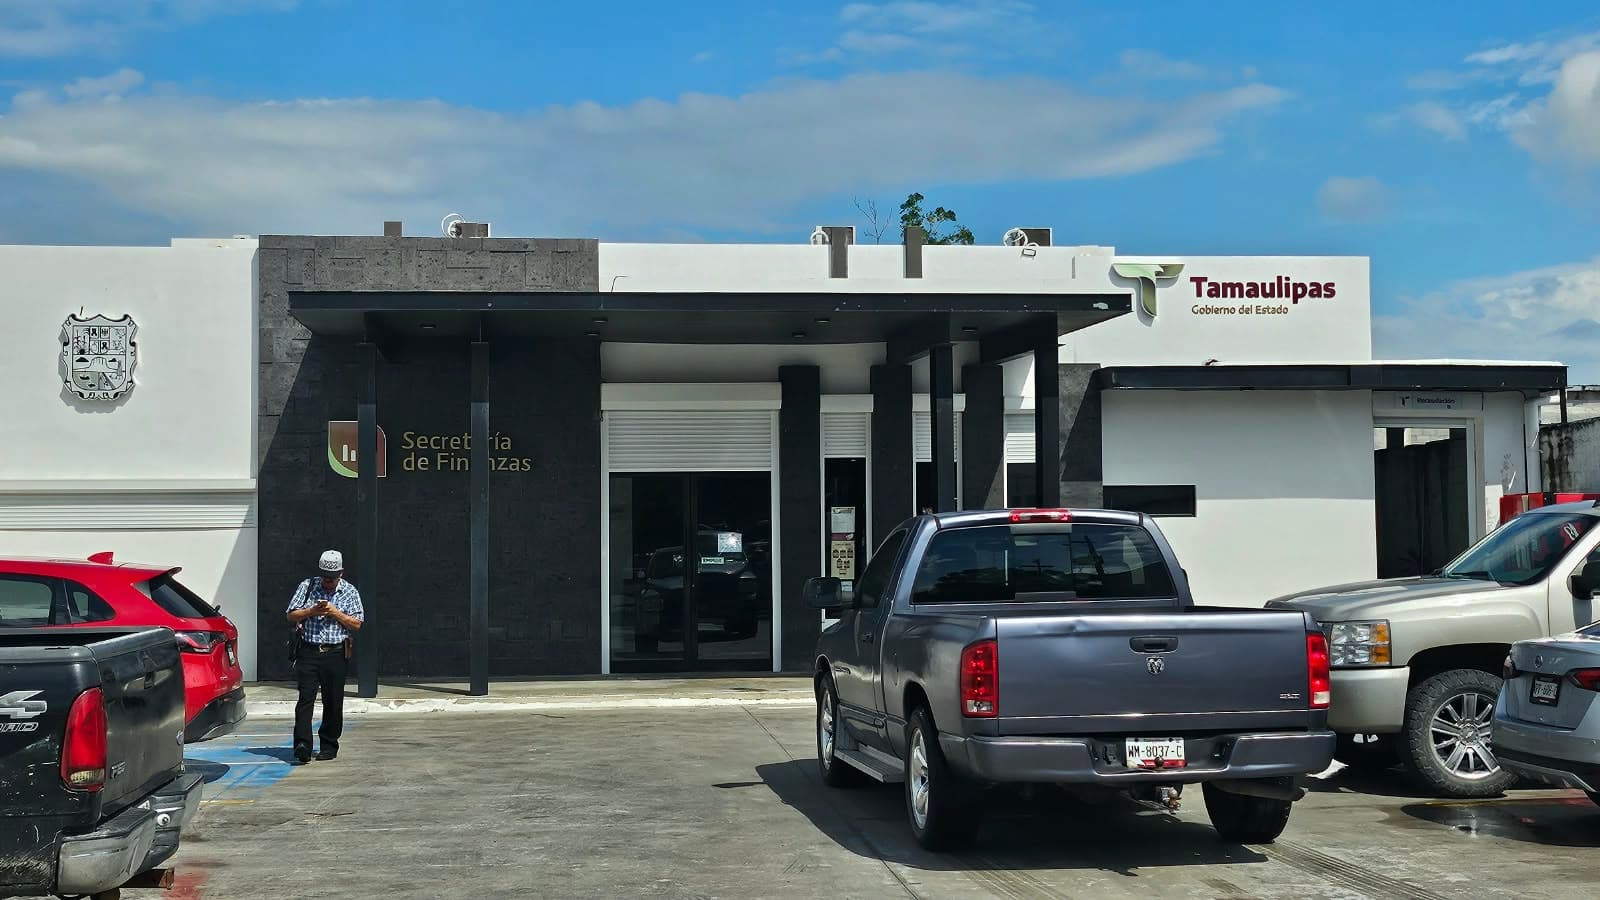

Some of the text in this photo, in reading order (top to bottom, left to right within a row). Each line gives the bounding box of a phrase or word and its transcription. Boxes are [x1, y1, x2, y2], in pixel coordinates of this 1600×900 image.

[1190, 275, 1336, 304] Tamaulipas
[1191, 304, 1289, 315] Gobierno del Estado
[401, 431, 511, 450] Secretía
[402, 452, 532, 471] de Finnzas
[1127, 745, 1183, 758] WM-8037-C
